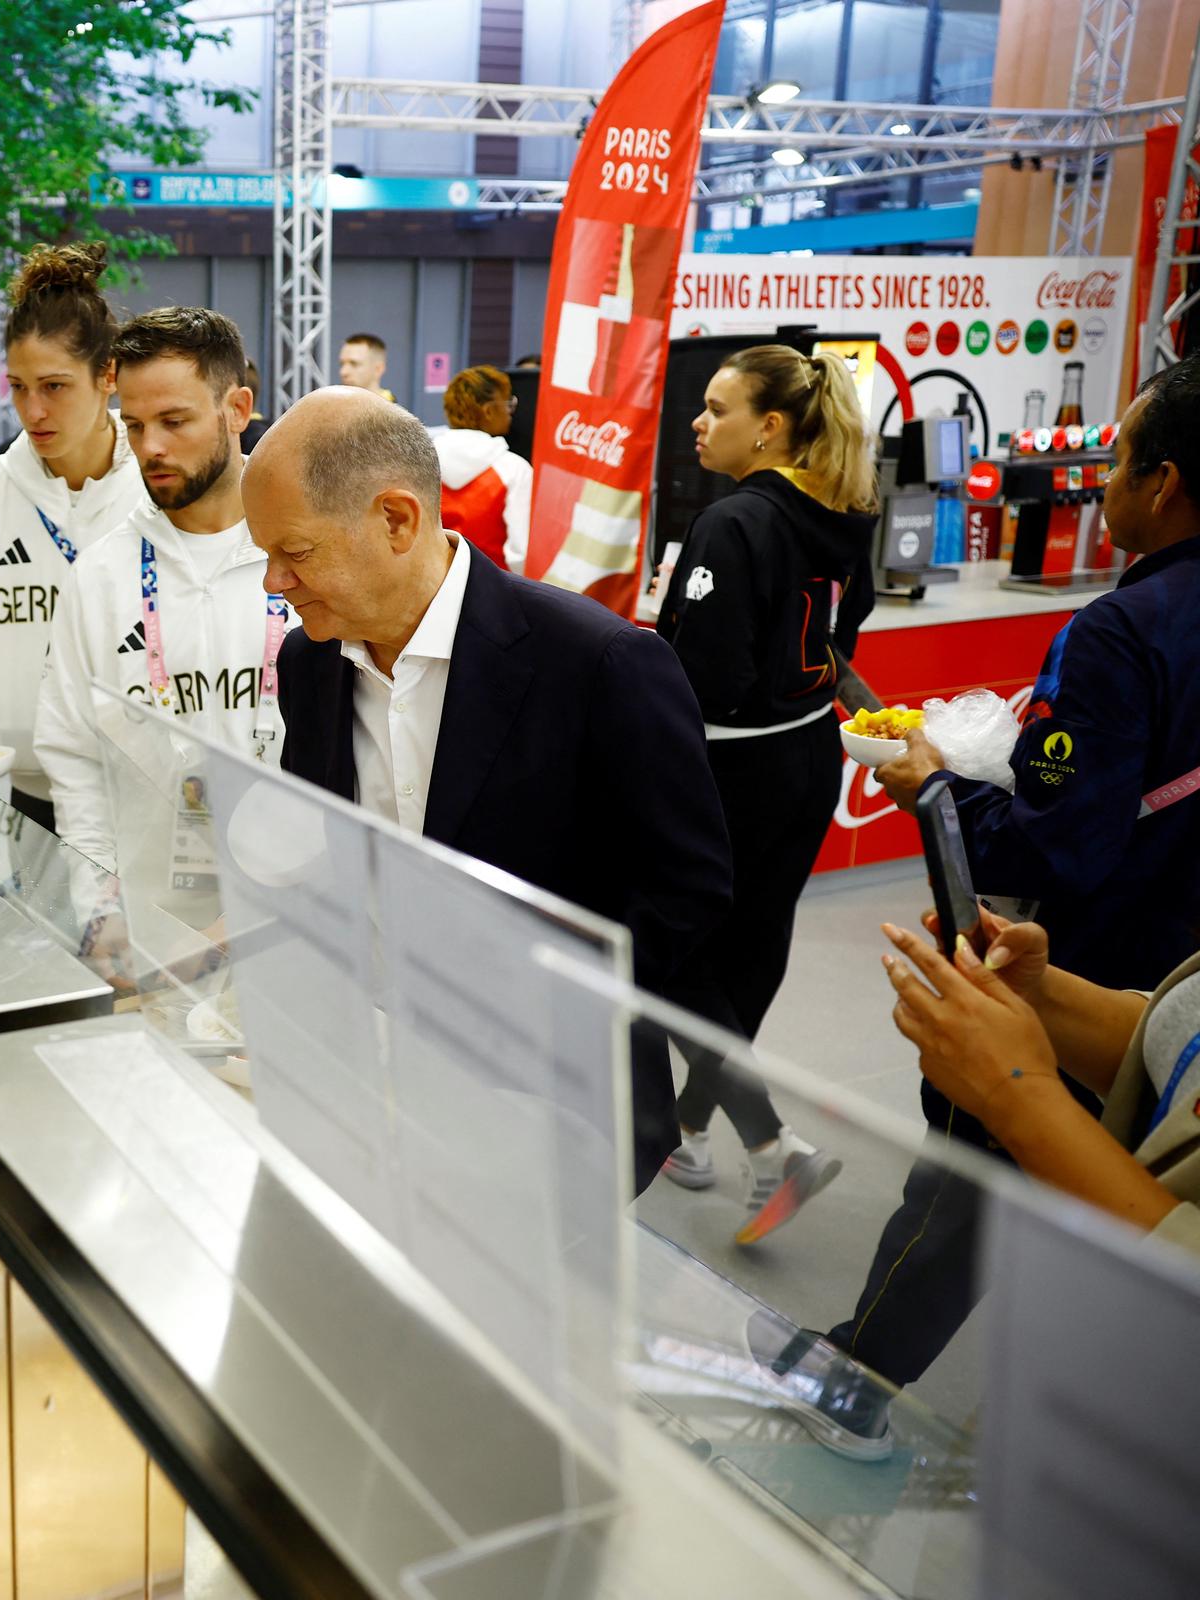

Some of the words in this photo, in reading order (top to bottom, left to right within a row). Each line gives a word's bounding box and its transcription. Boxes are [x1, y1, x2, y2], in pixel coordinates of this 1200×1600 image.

[600, 160, 668, 195] 2024
[758, 273, 865, 310] ATHLETES
[871, 274, 932, 310] SINCE
[938, 274, 991, 310] 1928.
[1036, 270, 1121, 310] Coca-Cola
[555, 410, 632, 468] Coca-Cola
[1029, 760, 1057, 770] PARIS
